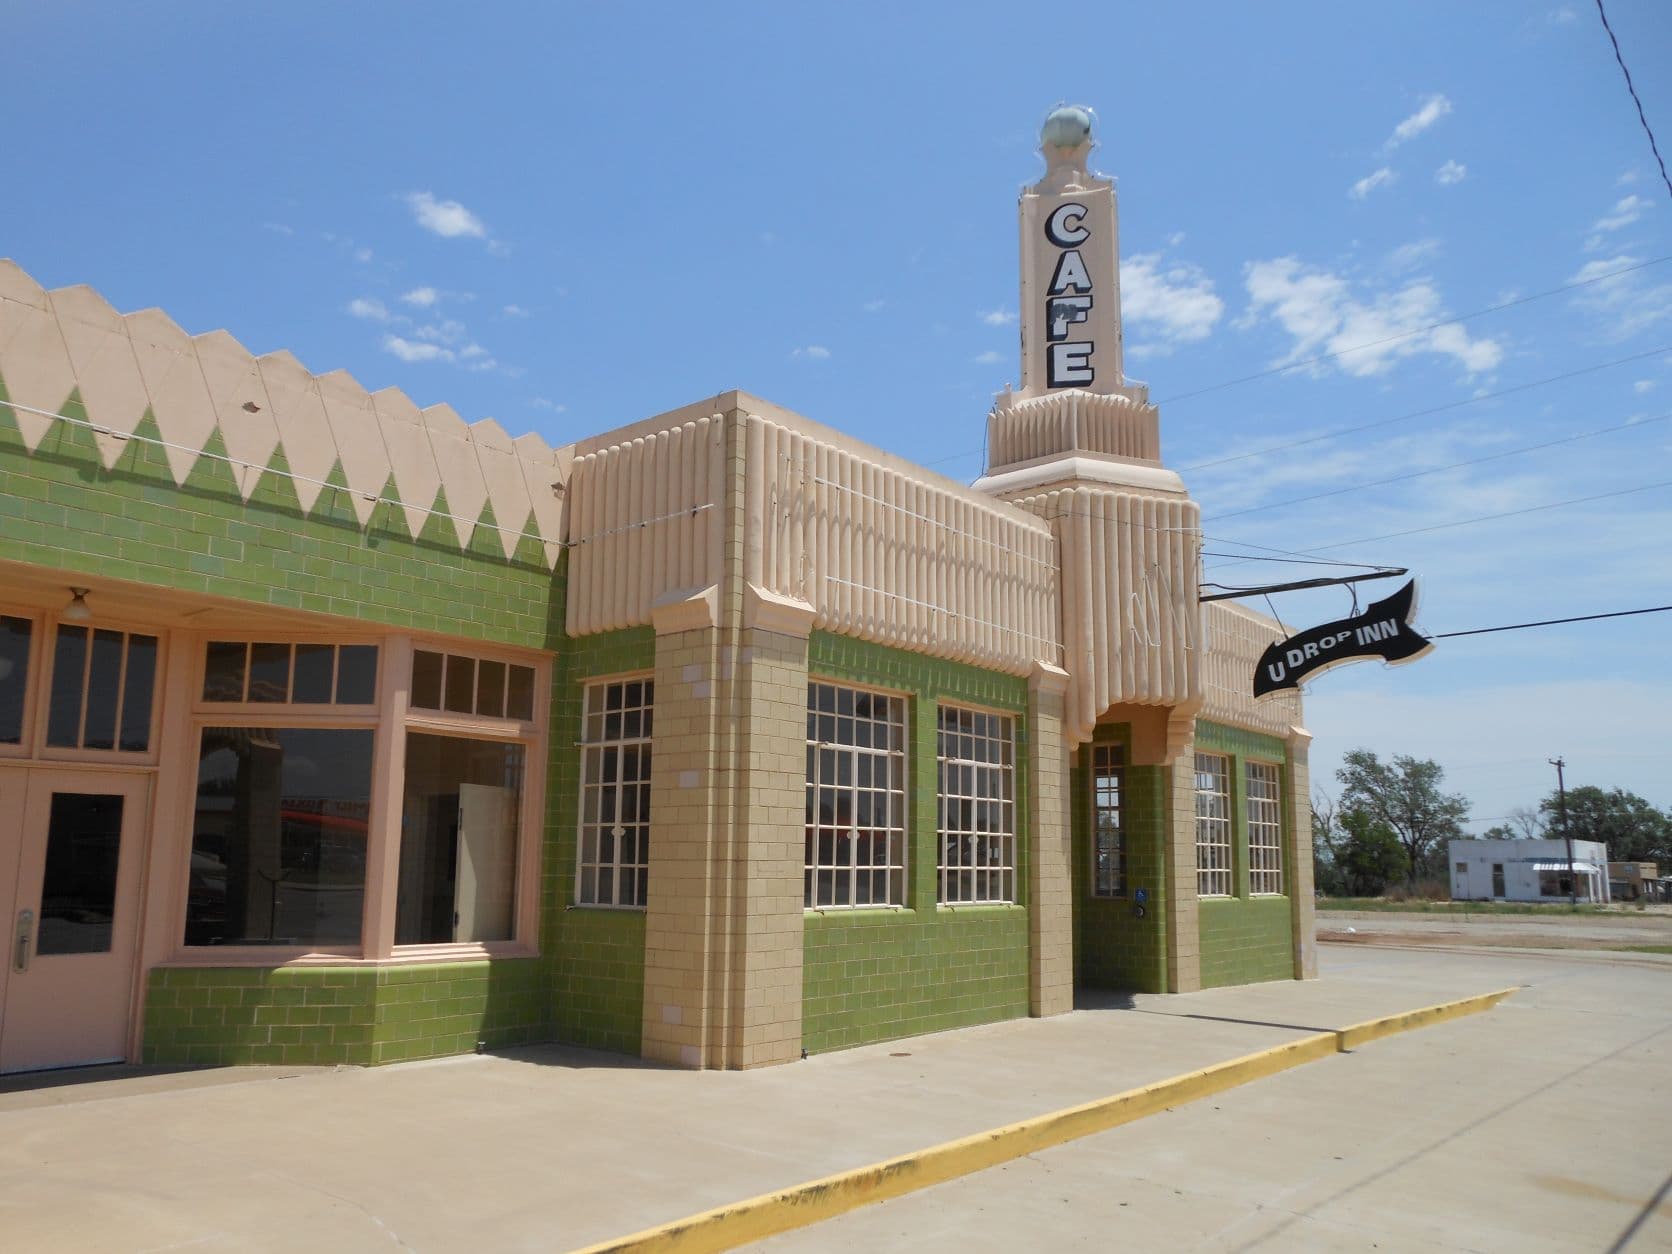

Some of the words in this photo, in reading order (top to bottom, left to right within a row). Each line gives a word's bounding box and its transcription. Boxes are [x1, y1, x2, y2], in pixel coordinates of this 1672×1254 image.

[1045, 203, 1094, 388] CAFE
[1268, 661, 1286, 682] U
[1286, 630, 1352, 668] DROP
[1355, 618, 1399, 646] INN
